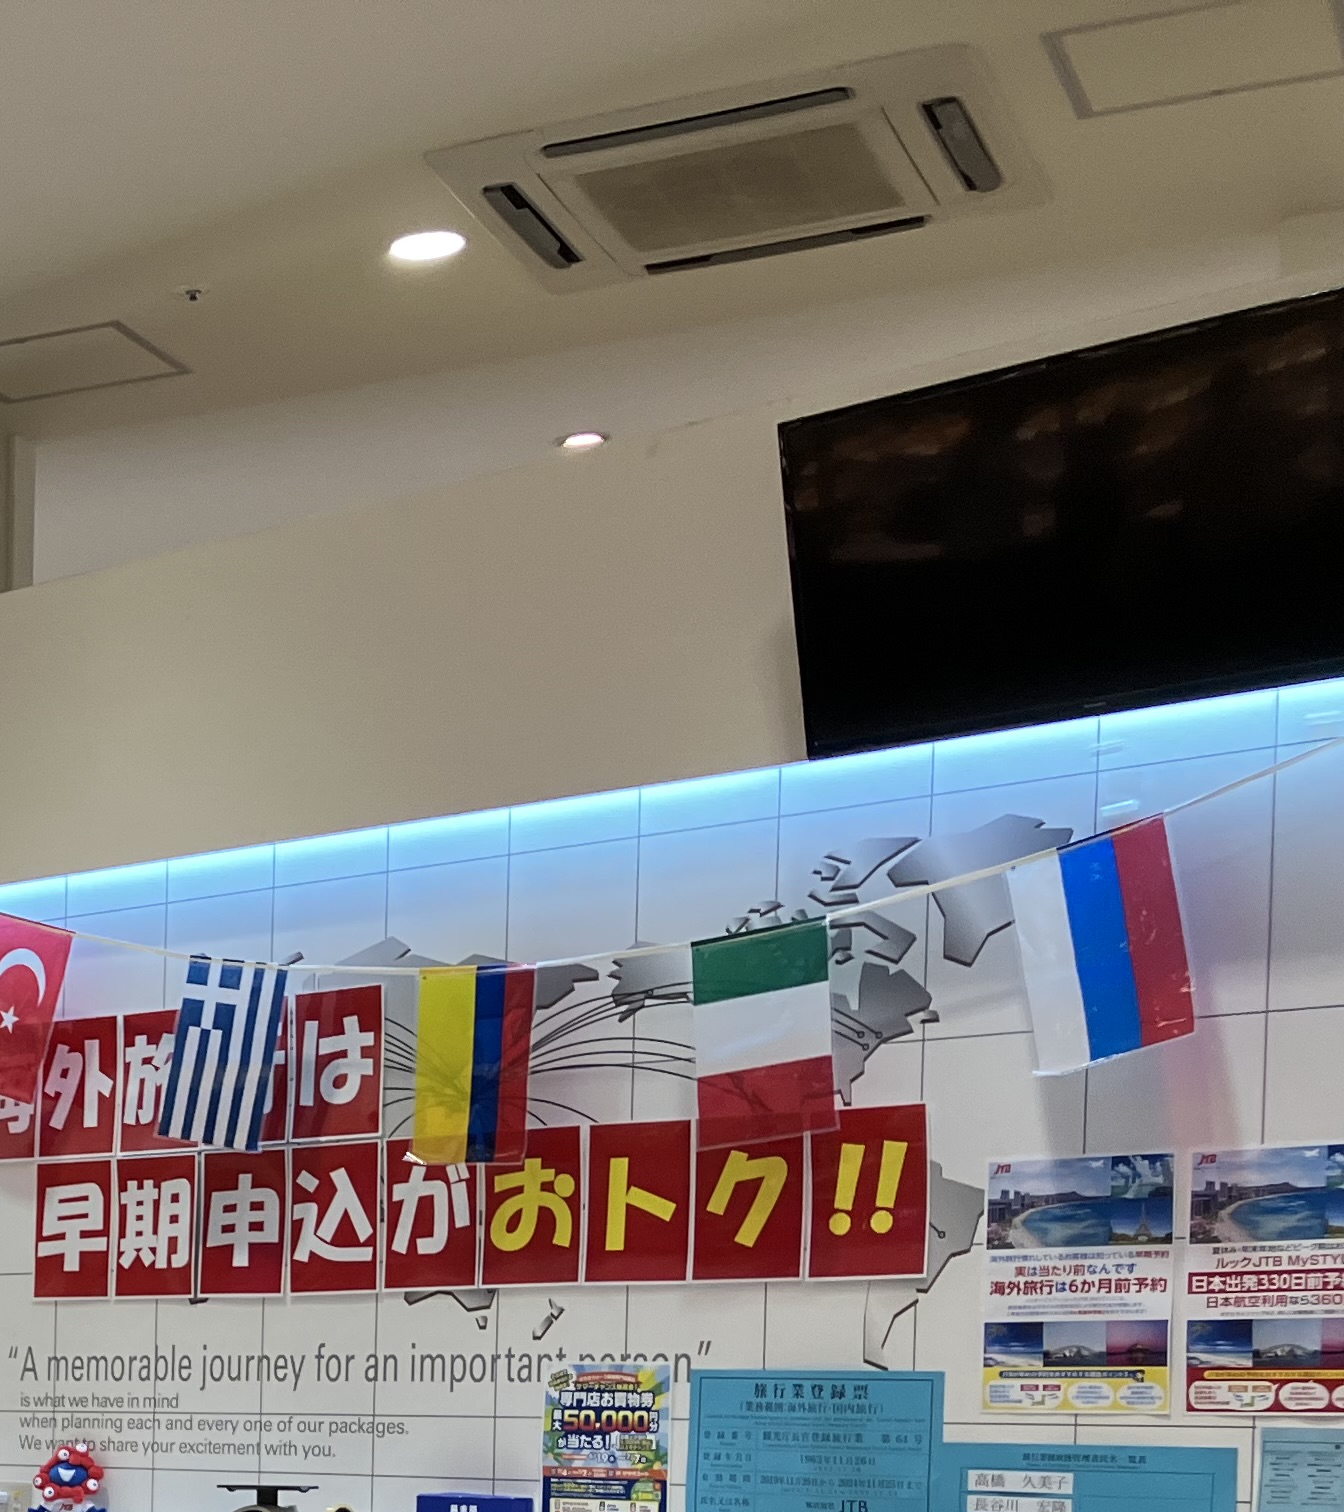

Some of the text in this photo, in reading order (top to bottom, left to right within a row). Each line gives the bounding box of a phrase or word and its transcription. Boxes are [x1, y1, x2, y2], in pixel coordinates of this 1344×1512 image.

[36, 1139, 910, 1273] 早期申込がおトク!!
[1014, 1262, 1137, 1277] 実は当たり前なんです
[1215, 1255, 1283, 1270] ルックJTB
[989, 1277, 1168, 1297] 海外旅行は6か月前予約
[1191, 1272, 1344, 1293] 日本出発330日前予
[46, 1344, 193, 1383] memorable
[199, 1344, 307, 1392] journey
[314, 1342, 356, 1383] for
[363, 1352, 399, 1383] an
[19, 1393, 179, 1409] is what we have in mind
[754, 1382, 869, 1400] 旅行業登録票
[19, 1415, 410, 1438] when planning each and every one of our packages.
[563, 1409, 648, 1432] 50,000
[19, 1434, 42, 1451] We
[99, 1437, 139, 1453] share
[141, 1440, 175, 1458] your
[178, 1439, 261, 1455] excitement
[265, 1440, 298, 1457] with
[301, 1443, 337, 1460] you.
[973, 1497, 1020, 1512] 長谷川
